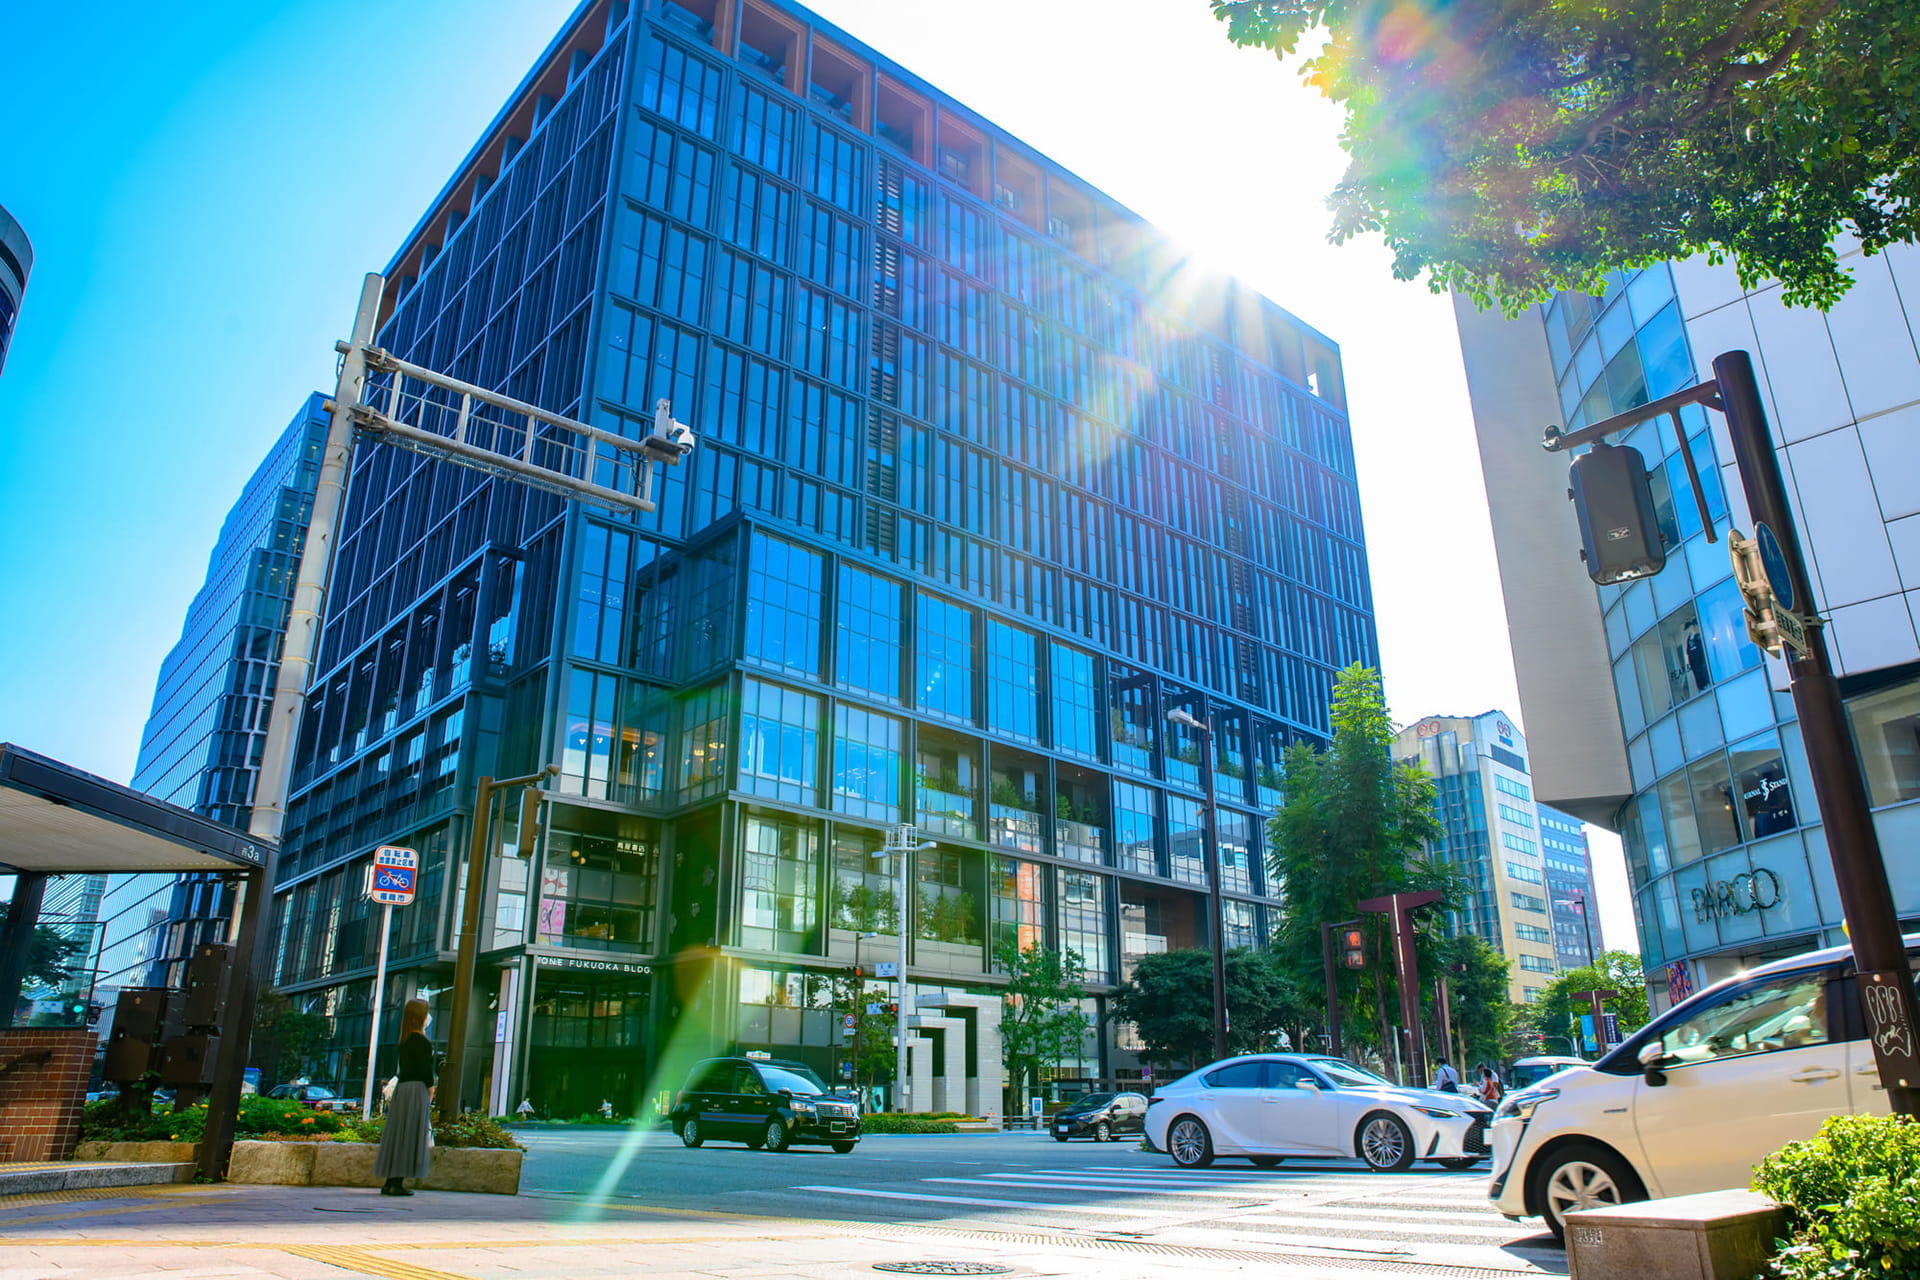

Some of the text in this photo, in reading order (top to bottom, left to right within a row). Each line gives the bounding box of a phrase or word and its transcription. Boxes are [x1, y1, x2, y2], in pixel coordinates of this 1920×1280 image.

[1690, 868, 1780, 925] PARCO
[540, 957, 654, 975] ONE FUKUOKA BLDG.
